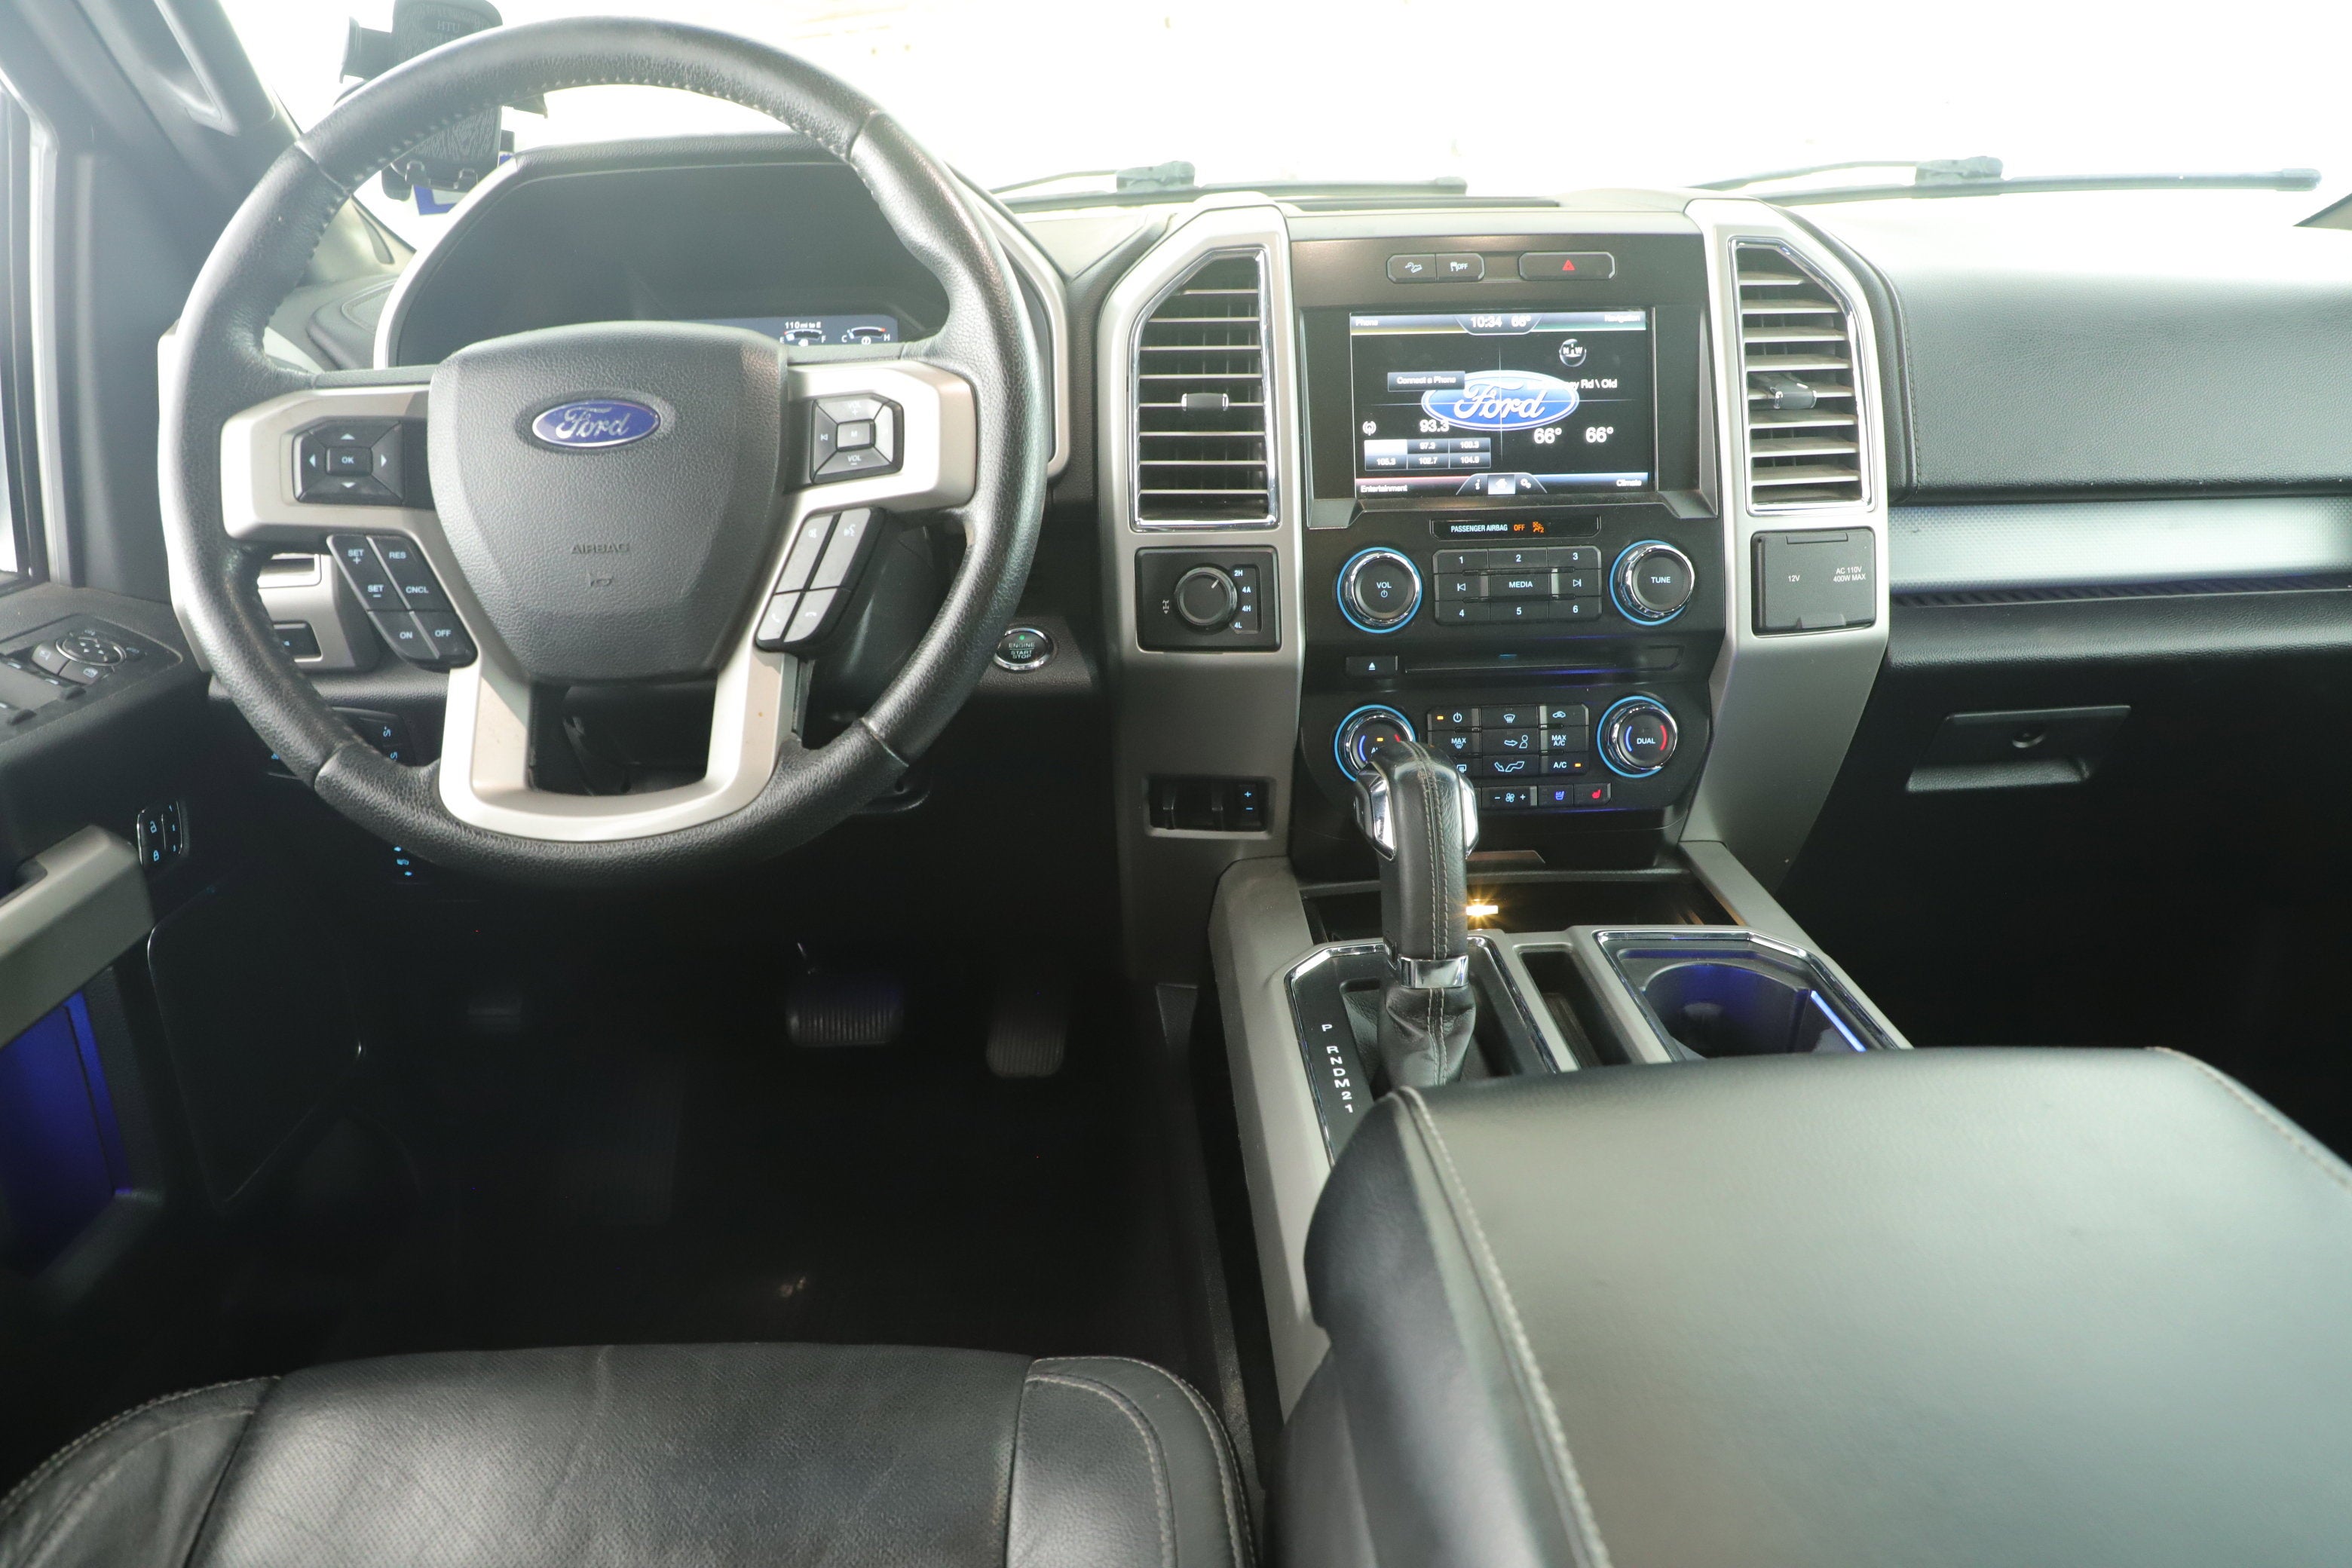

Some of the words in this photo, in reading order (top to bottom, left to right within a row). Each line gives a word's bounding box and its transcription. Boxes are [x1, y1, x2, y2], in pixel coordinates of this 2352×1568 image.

[1457, 262, 1468, 271] OFF
[1355, 318, 1379, 326] Phone
[1471, 315, 1502, 327] 10:34
[1604, 314, 1641, 323] Navigation
[785, 321, 800, 329] 110
[841, 335, 847, 343] C
[1396, 376, 1426, 384] Connect
[1433, 375, 1456, 384] Phone
[1581, 379, 1594, 388] Rd
[1601, 378, 1618, 388] Old
[1453, 378, 1546, 421] Ford
[556, 406, 632, 439] Ford
[1419, 419, 1450, 433] 93.3
[1533, 427, 1563, 444] 66°
[1585, 426, 1614, 443] 66°
[341, 456, 354, 464] OK
[1615, 479, 1642, 487] Climate
[1360, 484, 1408, 493] Entertainment
[1450, 525, 1486, 533] PASSENGER
[1486, 524, 1508, 532] AIRBAG
[348, 549, 364, 557] SET
[571, 543, 630, 555] AIRBAG
[388, 551, 406, 559] RES
[1516, 554, 1521, 562] 2
[1573, 552, 1579, 560] 3
[1833, 574, 1851, 583] 400W
[367, 584, 384, 593] SET
[1508, 580, 1533, 589] MEDIA
[406, 586, 428, 594] CNCL
[1459, 609, 1465, 617] 4
[1516, 607, 1522, 615] 5
[1573, 605, 1579, 614] 6
[400, 631, 413, 639] ON
[434, 629, 452, 638] OFF
[1637, 737, 1655, 745] DUAL
[1321, 1024, 1333, 1032] P
[1326, 1046, 1339, 1054] R
[1330, 1056, 1343, 1065] N
[1333, 1067, 1346, 1076] D
[1334, 1078, 1350, 1089] M
[1341, 1091, 1352, 1100] 2
[1345, 1104, 1353, 1113] 1
